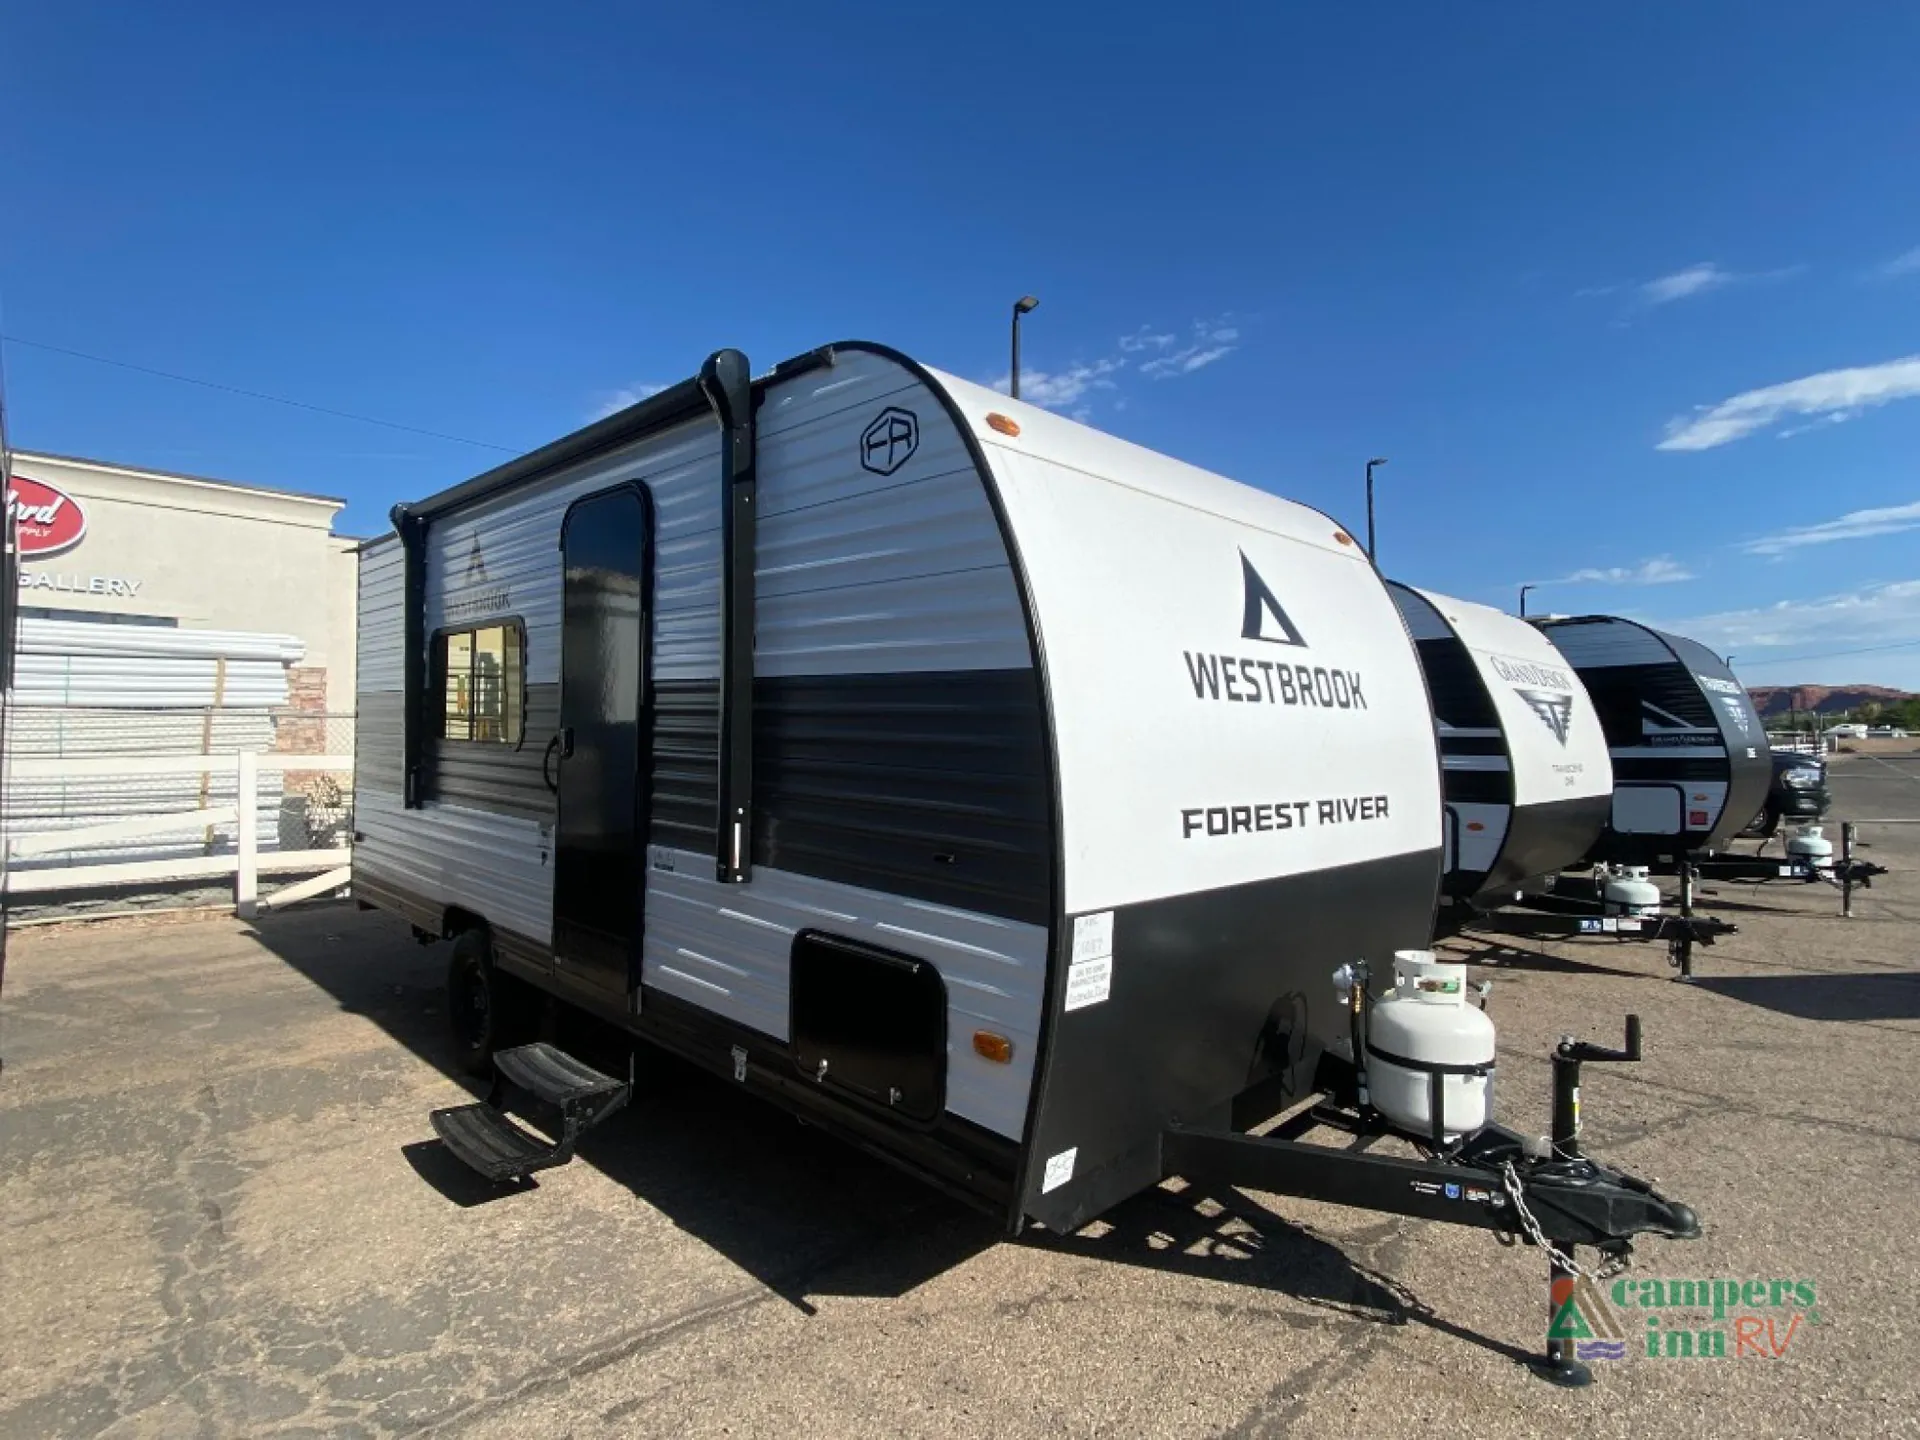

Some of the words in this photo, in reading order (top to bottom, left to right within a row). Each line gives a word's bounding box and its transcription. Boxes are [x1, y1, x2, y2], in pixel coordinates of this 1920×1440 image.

[19, 570, 142, 597] GALLERY
[1183, 650, 1368, 711] WESTBROOK
[1181, 801, 1311, 838] FOREST
[1316, 795, 1390, 826] RIVER
